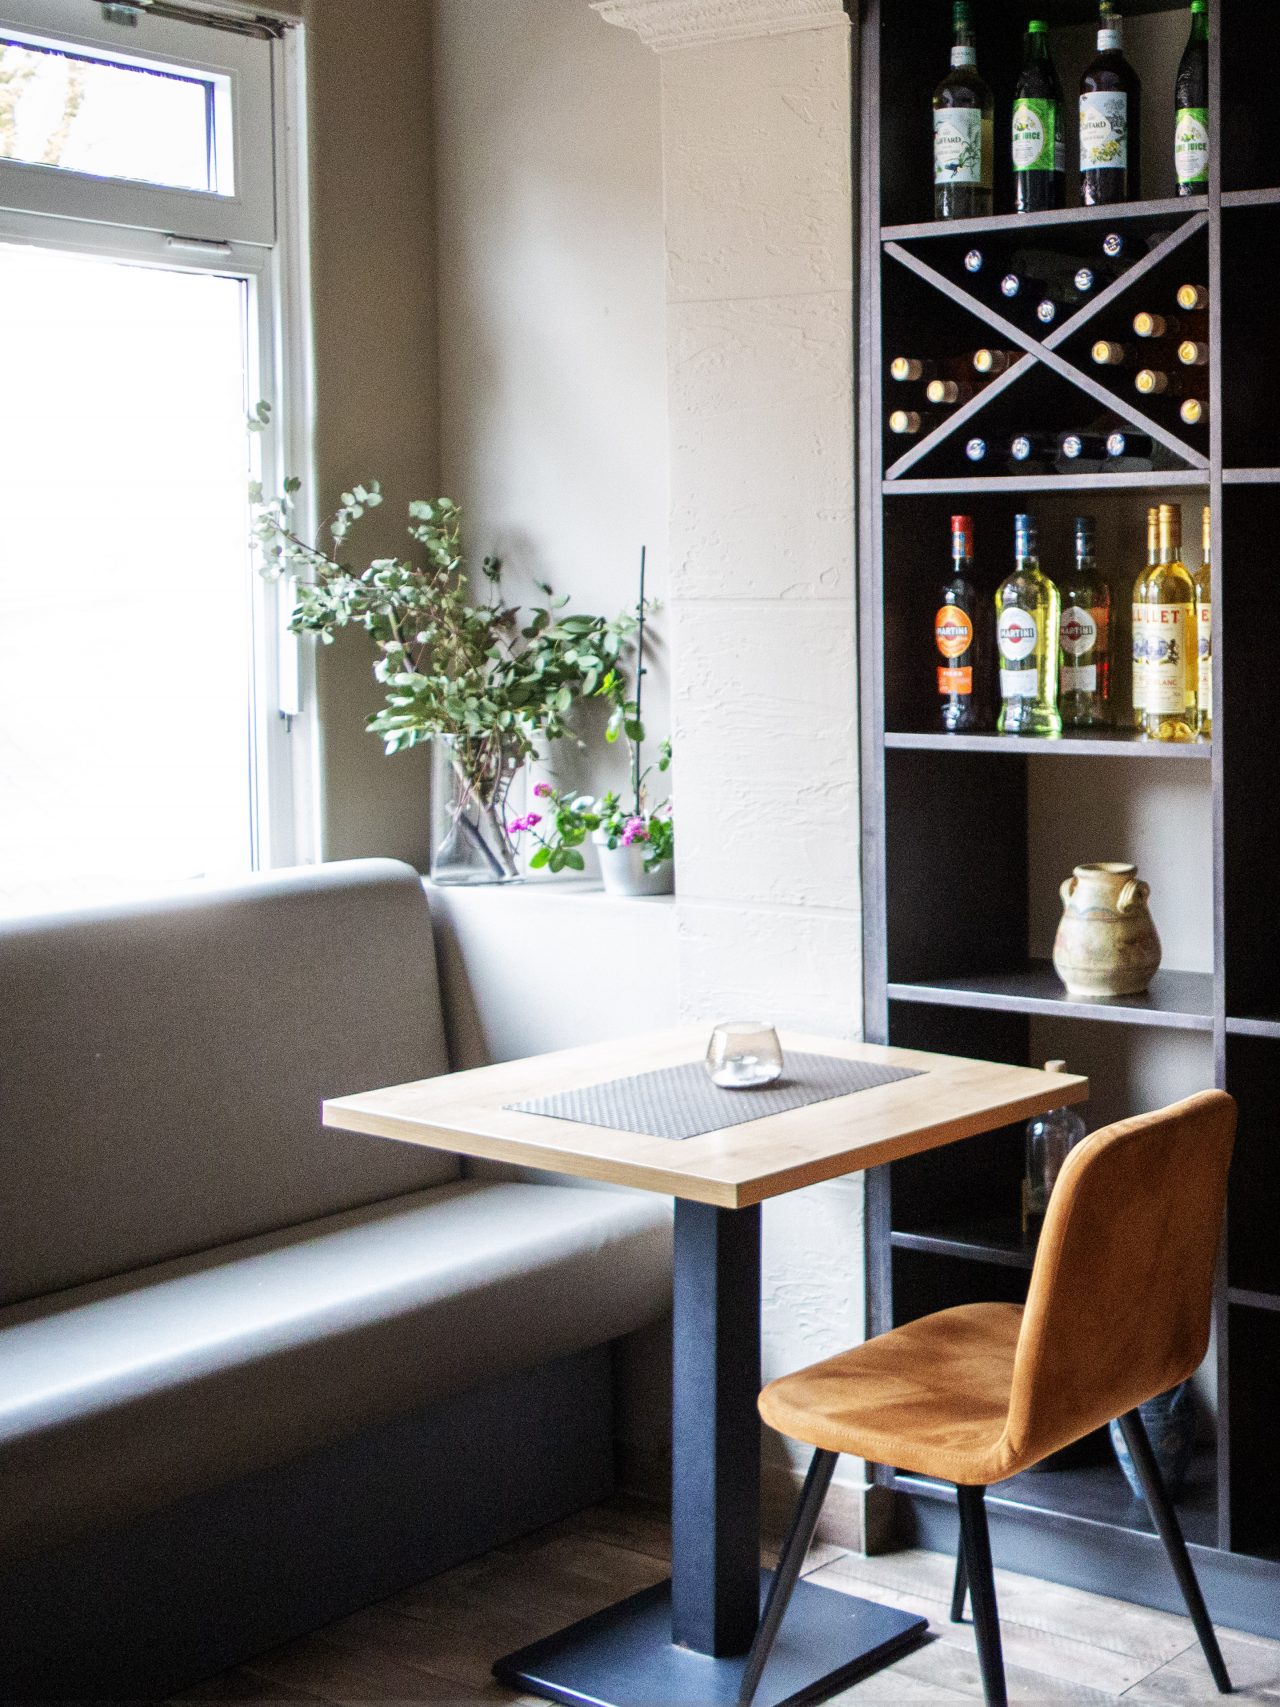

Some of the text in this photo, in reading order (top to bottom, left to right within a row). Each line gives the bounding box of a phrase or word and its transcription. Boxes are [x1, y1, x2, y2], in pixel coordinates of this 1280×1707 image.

[936, 626, 968, 636] MARTINI
[1000, 628, 1034, 638] MARTINI
[1060, 625, 1093, 635] MARTINI
